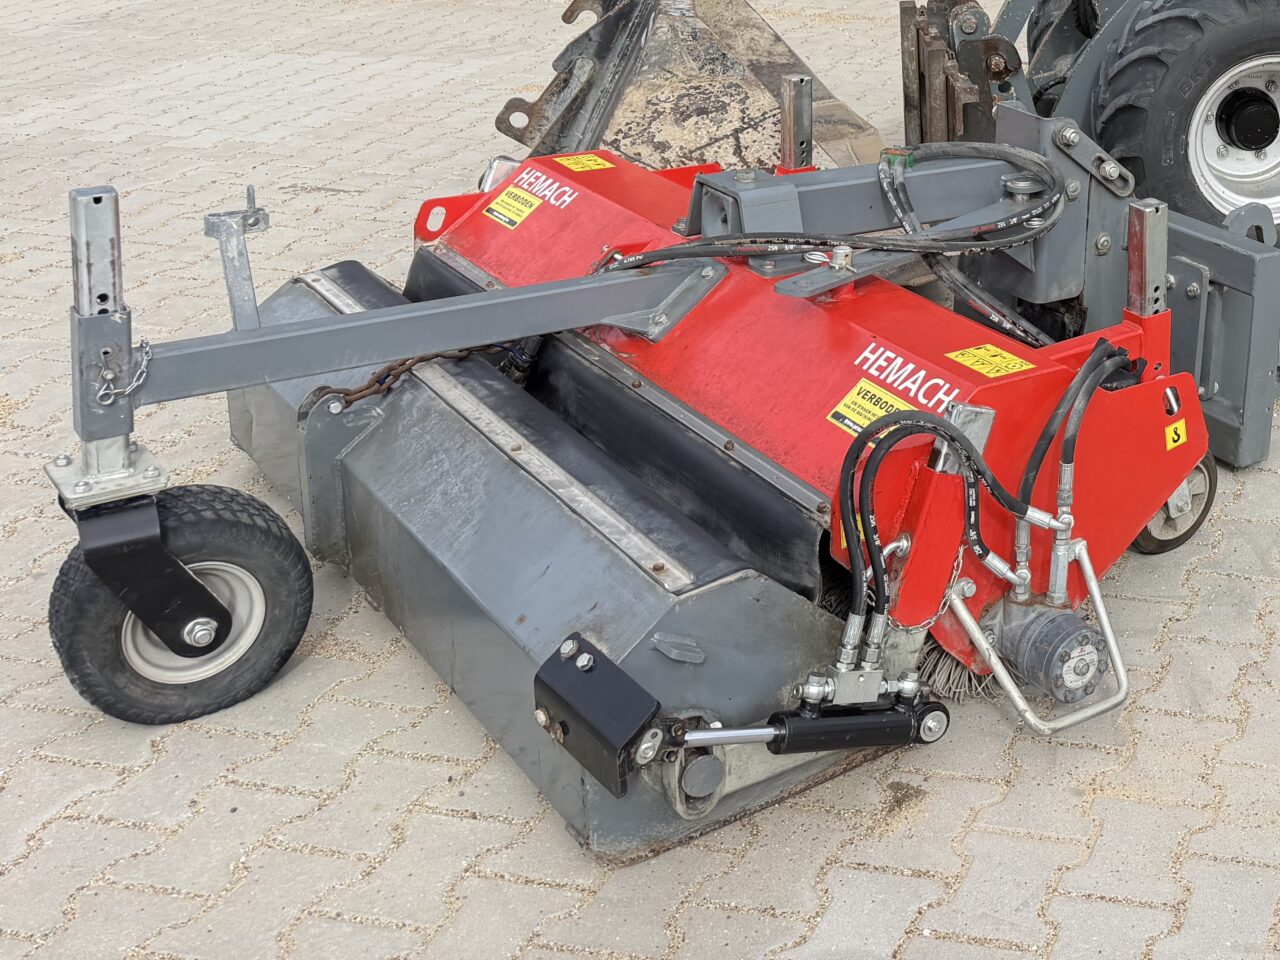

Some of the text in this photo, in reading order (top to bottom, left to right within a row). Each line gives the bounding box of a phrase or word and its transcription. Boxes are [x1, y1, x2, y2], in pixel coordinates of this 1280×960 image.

[504, 190, 536, 210] VERBODEN
[514, 166, 579, 209] HEMACH
[854, 342, 960, 413] HEMACH
[856, 386, 902, 414] VERBOD
